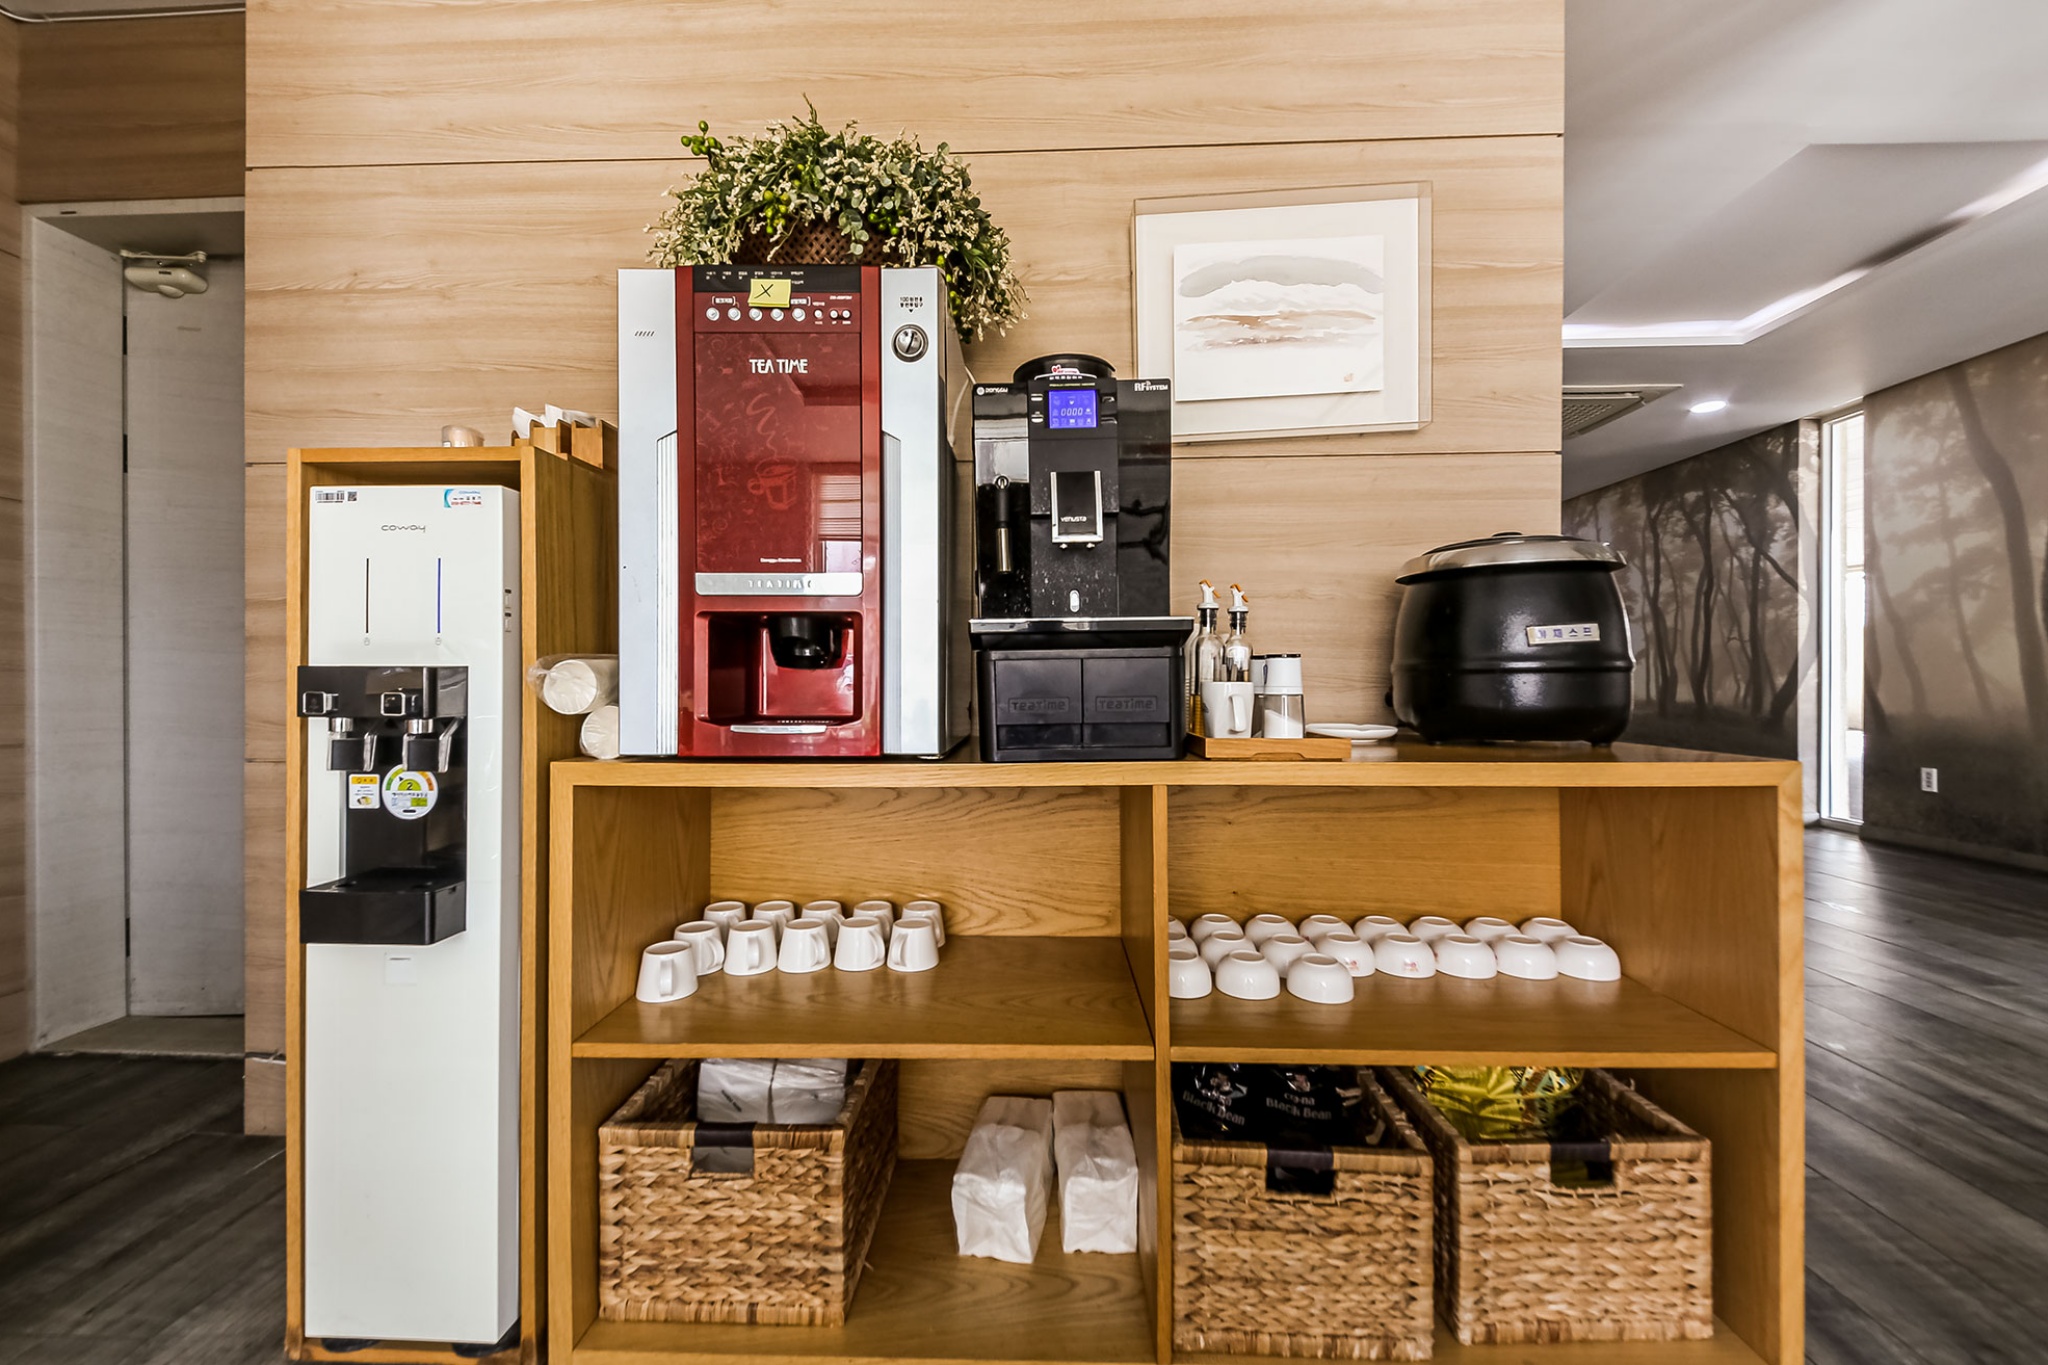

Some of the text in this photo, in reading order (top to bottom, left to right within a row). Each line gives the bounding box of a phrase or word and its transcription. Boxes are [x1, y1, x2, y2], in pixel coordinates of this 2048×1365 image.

[749, 358, 808, 374] TEA TIME
[406, 781, 414, 791] 2
[1265, 1096, 1333, 1121] Black Bean
